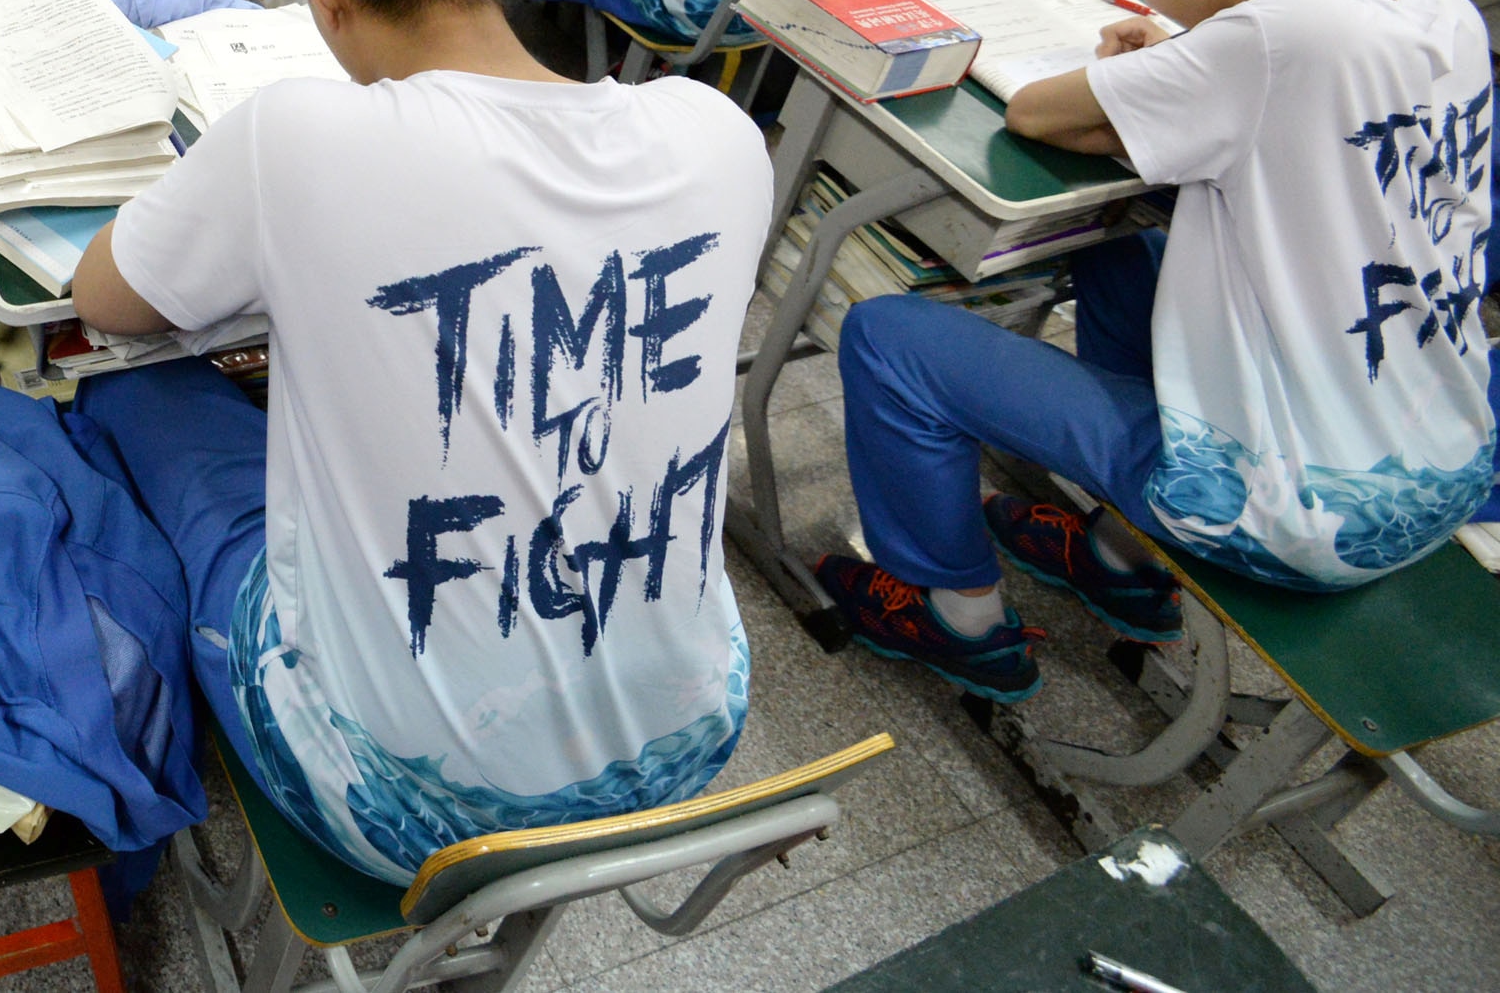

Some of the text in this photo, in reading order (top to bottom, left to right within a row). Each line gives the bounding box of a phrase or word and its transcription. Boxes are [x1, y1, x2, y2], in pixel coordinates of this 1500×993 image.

[366, 232, 720, 468] TIME
[533, 397, 614, 488] TO
[382, 417, 731, 662] FIGHT
